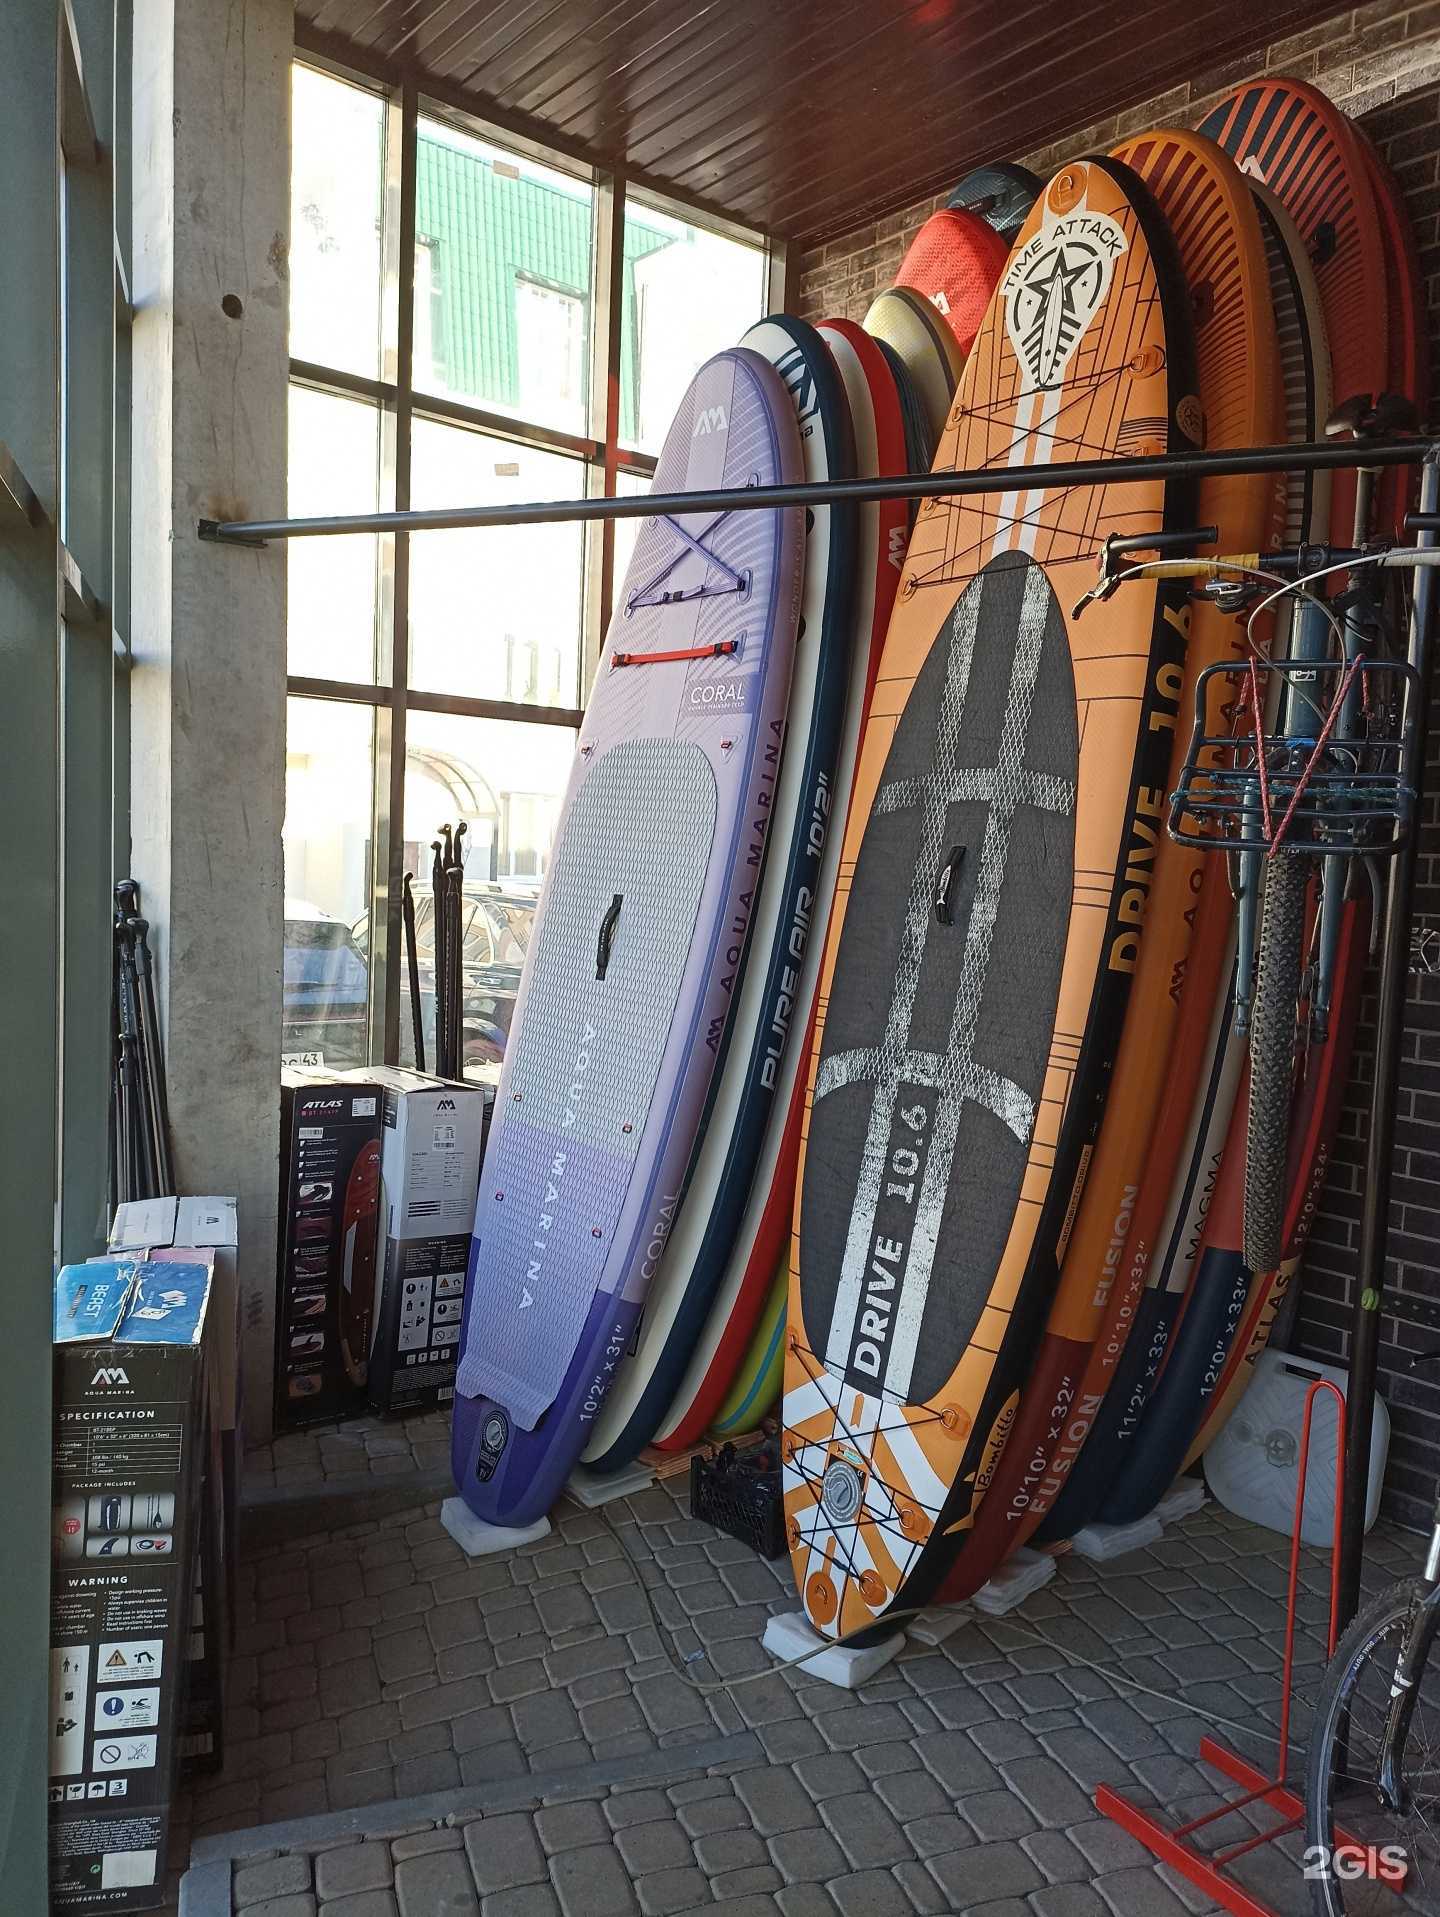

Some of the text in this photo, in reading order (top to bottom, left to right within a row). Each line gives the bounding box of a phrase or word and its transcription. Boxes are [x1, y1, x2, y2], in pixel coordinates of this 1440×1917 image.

[1003, 218, 1123, 290] TIME ATTACK
[690, 682, 745, 704] CORAL
[719, 891, 753, 997] AQUA
[746, 717, 786, 868] MARINA
[1107, 784, 1164, 975] DRIVE
[759, 968, 800, 1092] PURE
[787, 885, 813, 962] AIR
[302, 1053, 318, 1067] 43
[302, 1099, 344, 1110] ATLAS
[517, 1022, 598, 1312] AQUA MARINA
[640, 1192, 677, 1282] CORAL
[853, 1104, 928, 1379] DRIVE 10.6
[1092, 1184, 1139, 1308] FUSION
[83, 1283, 110, 1319] BEAST
[607, 1323, 624, 1356] 31"
[1243, 1271, 1294, 1367] ATLAS
[59, 1410, 155, 1421] SPECIFICATION
[1029, 1393, 1101, 1514] FUSION
[68, 1576, 128, 1587] WARNING
